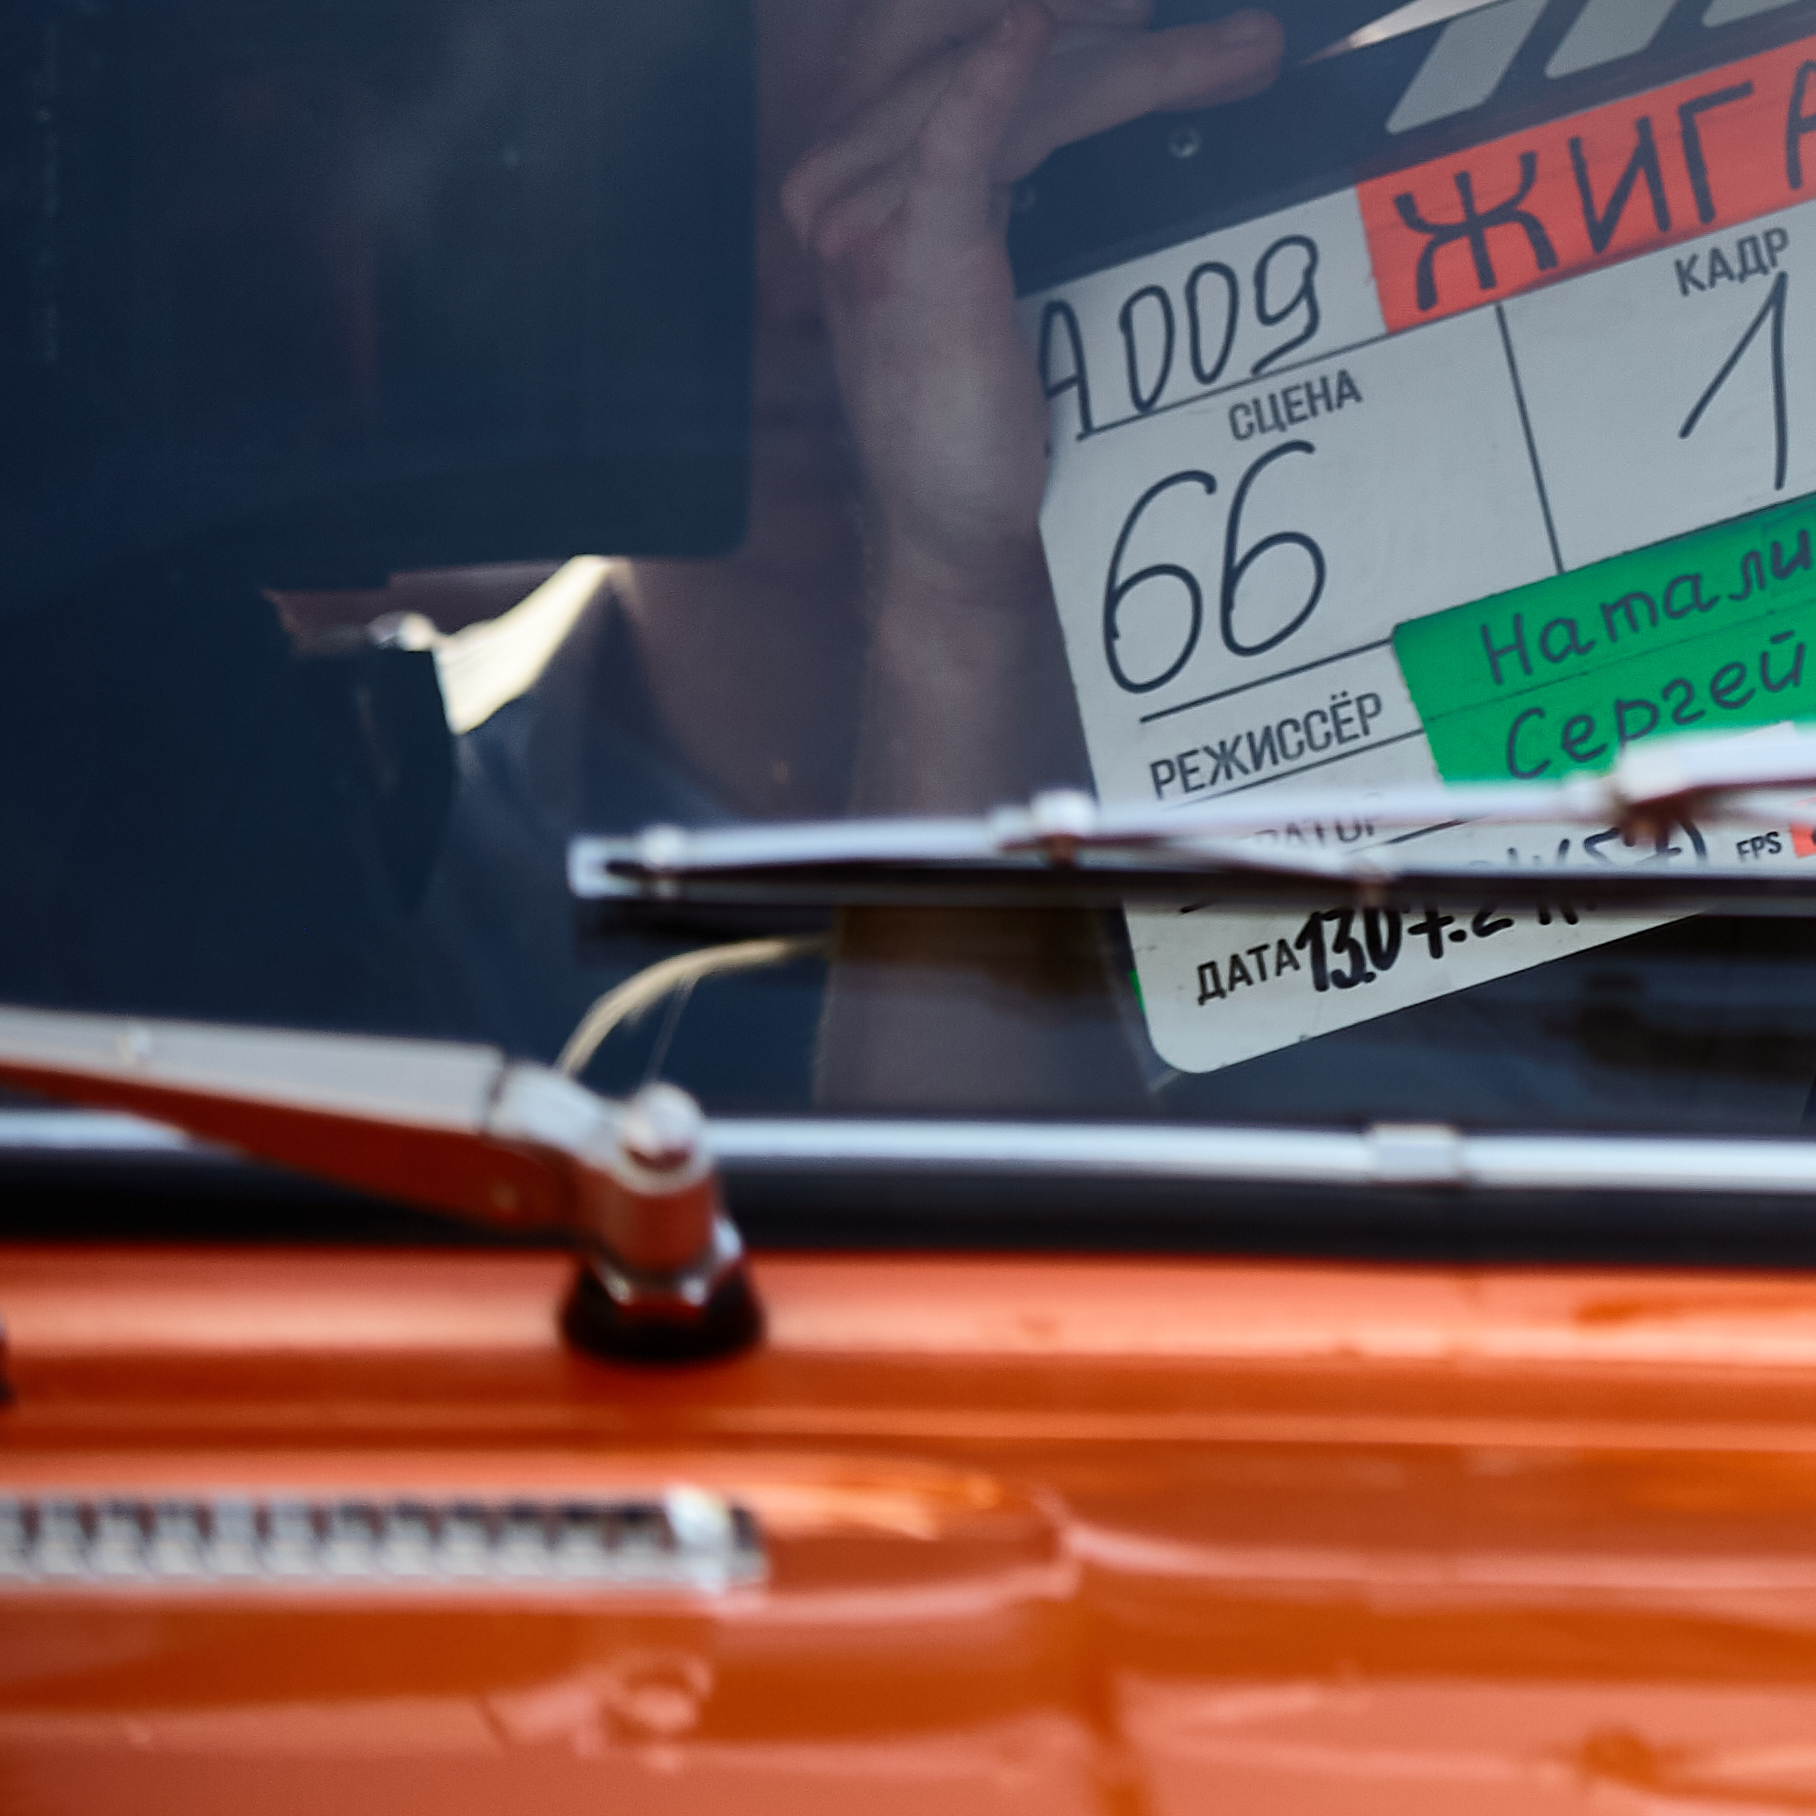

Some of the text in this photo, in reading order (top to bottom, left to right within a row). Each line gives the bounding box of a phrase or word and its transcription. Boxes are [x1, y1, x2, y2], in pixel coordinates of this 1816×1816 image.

[1674, 225, 1790, 297] КАДР
[1228, 368, 1363, 441] СЦЕНА
[1679, 271, 1788, 491] 1
[1103, 440, 1326, 693] 66
[1149, 689, 1384, 800] РЕЖИССЁР
[1505, 631, 1805, 780] Сергей
[1736, 830, 1783, 861] FPS
[1197, 938, 1301, 1006] ДАТА
